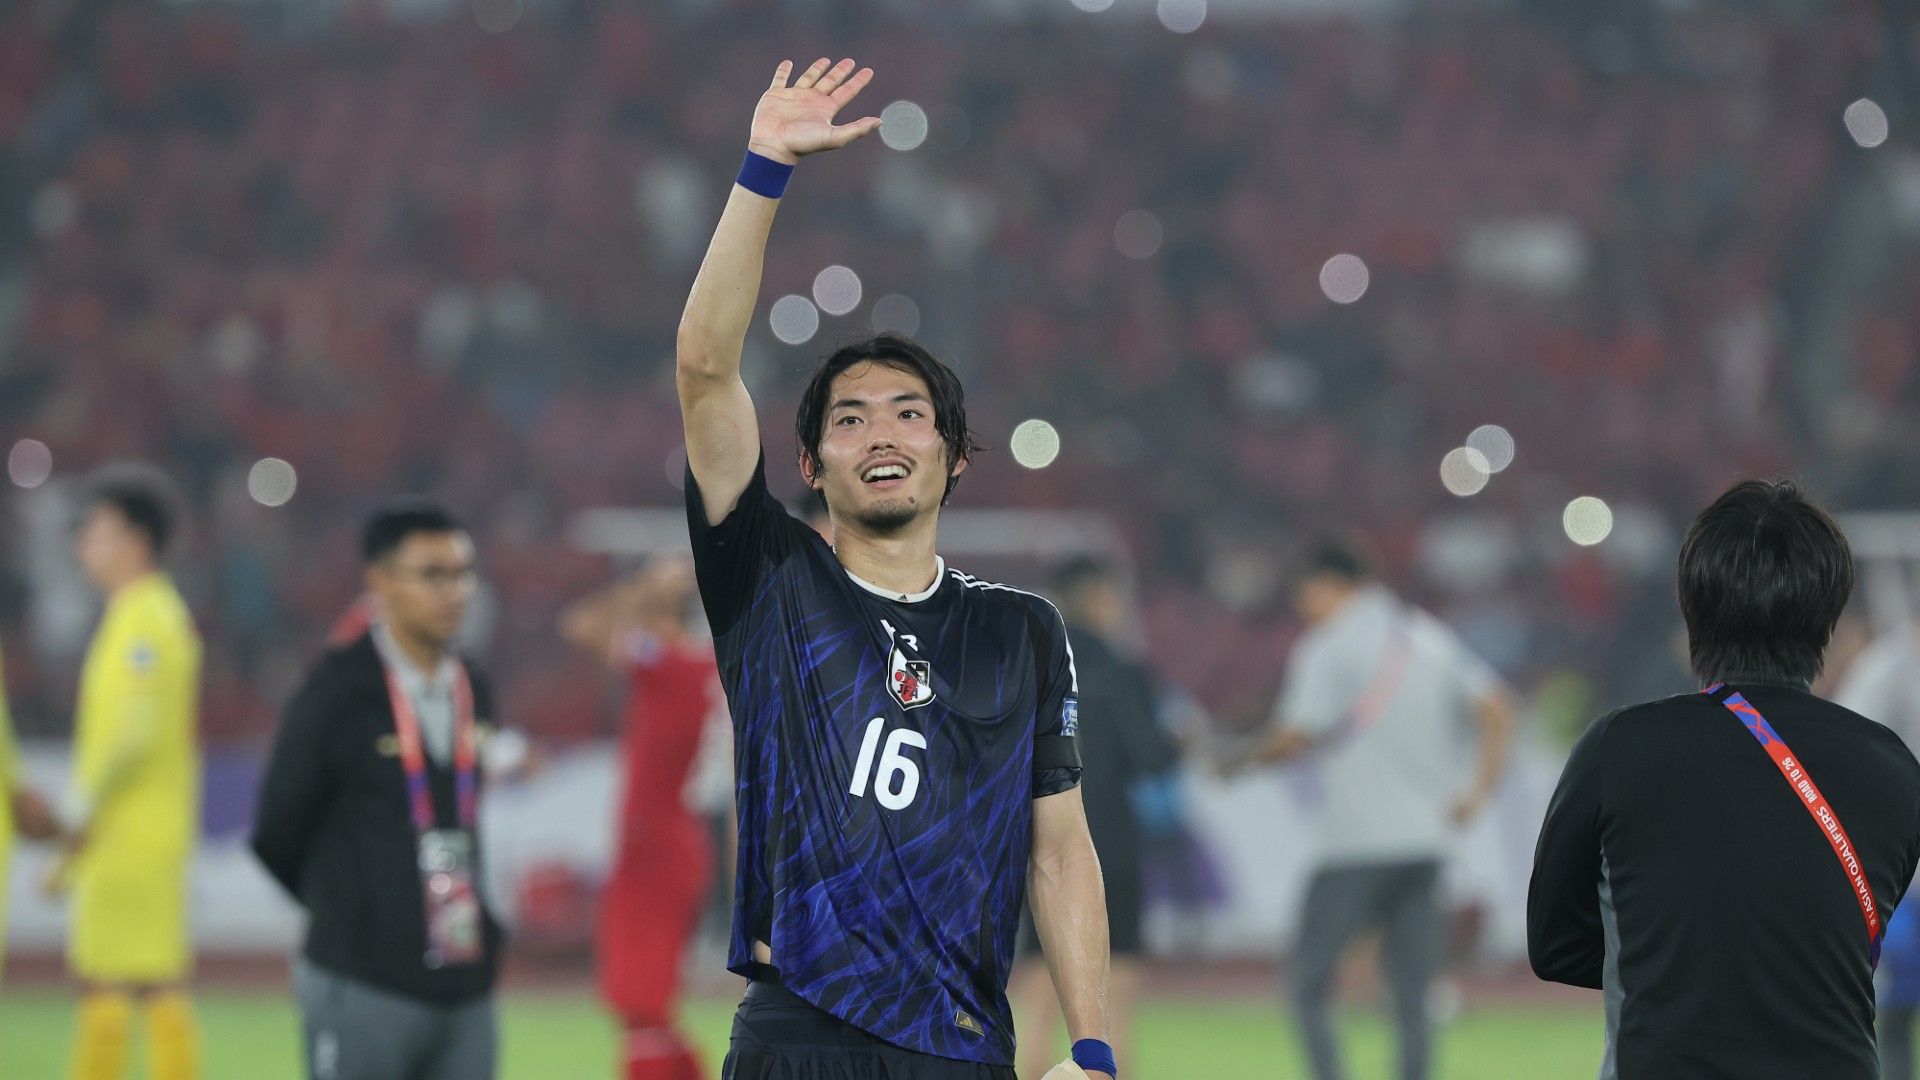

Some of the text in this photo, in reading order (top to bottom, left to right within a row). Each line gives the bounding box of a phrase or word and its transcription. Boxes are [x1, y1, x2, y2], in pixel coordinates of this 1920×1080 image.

[849, 717, 927, 810] 16
[1782, 757, 1873, 912] ASIAN QUALIFIERS ROAD TO 26
